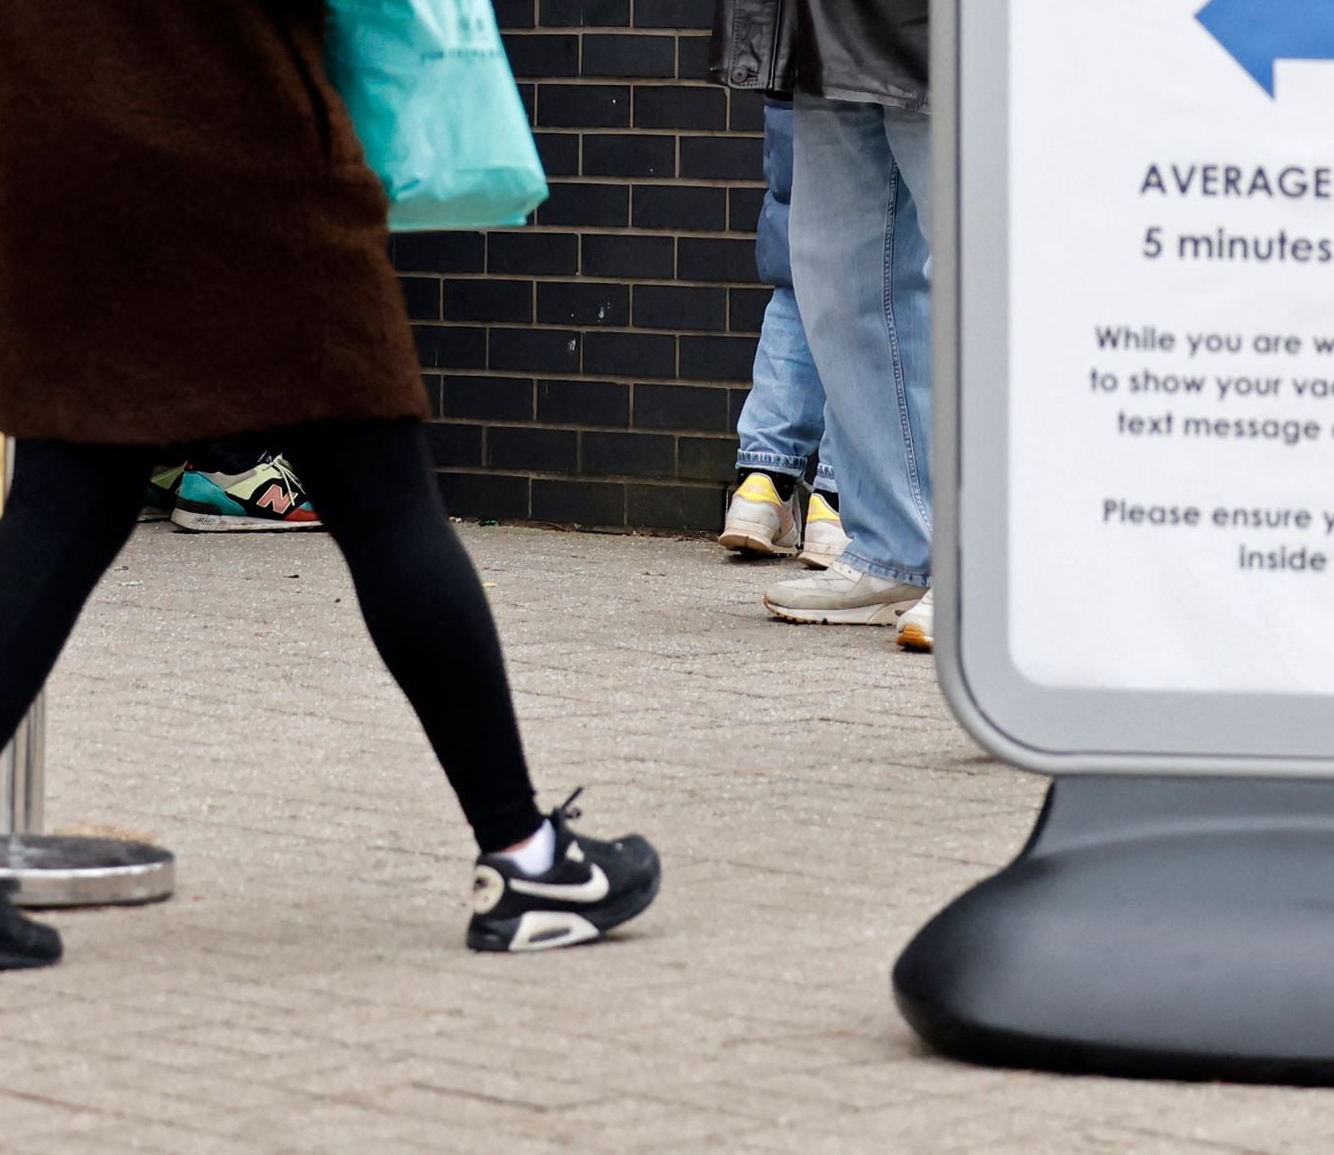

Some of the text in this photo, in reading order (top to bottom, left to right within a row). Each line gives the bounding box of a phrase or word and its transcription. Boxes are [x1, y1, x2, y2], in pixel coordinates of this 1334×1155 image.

[1139, 163, 1332, 200] AVERAGE
[1142, 227, 1163, 259] 5
[1177, 228, 1333, 263] minutes
[1095, 326, 1176, 352] While
[1186, 333, 1242, 357] you
[1252, 335, 1303, 355] are
[1089, 368, 1119, 393] to
[1129, 369, 1205, 395] show
[1216, 376, 1281, 400] your
[1116, 411, 1175, 437] text
[1183, 416, 1321, 446] message
[1102, 498, 1201, 526] Please
[1211, 506, 1312, 529] ensure
[1237, 545, 1328, 574] inside
